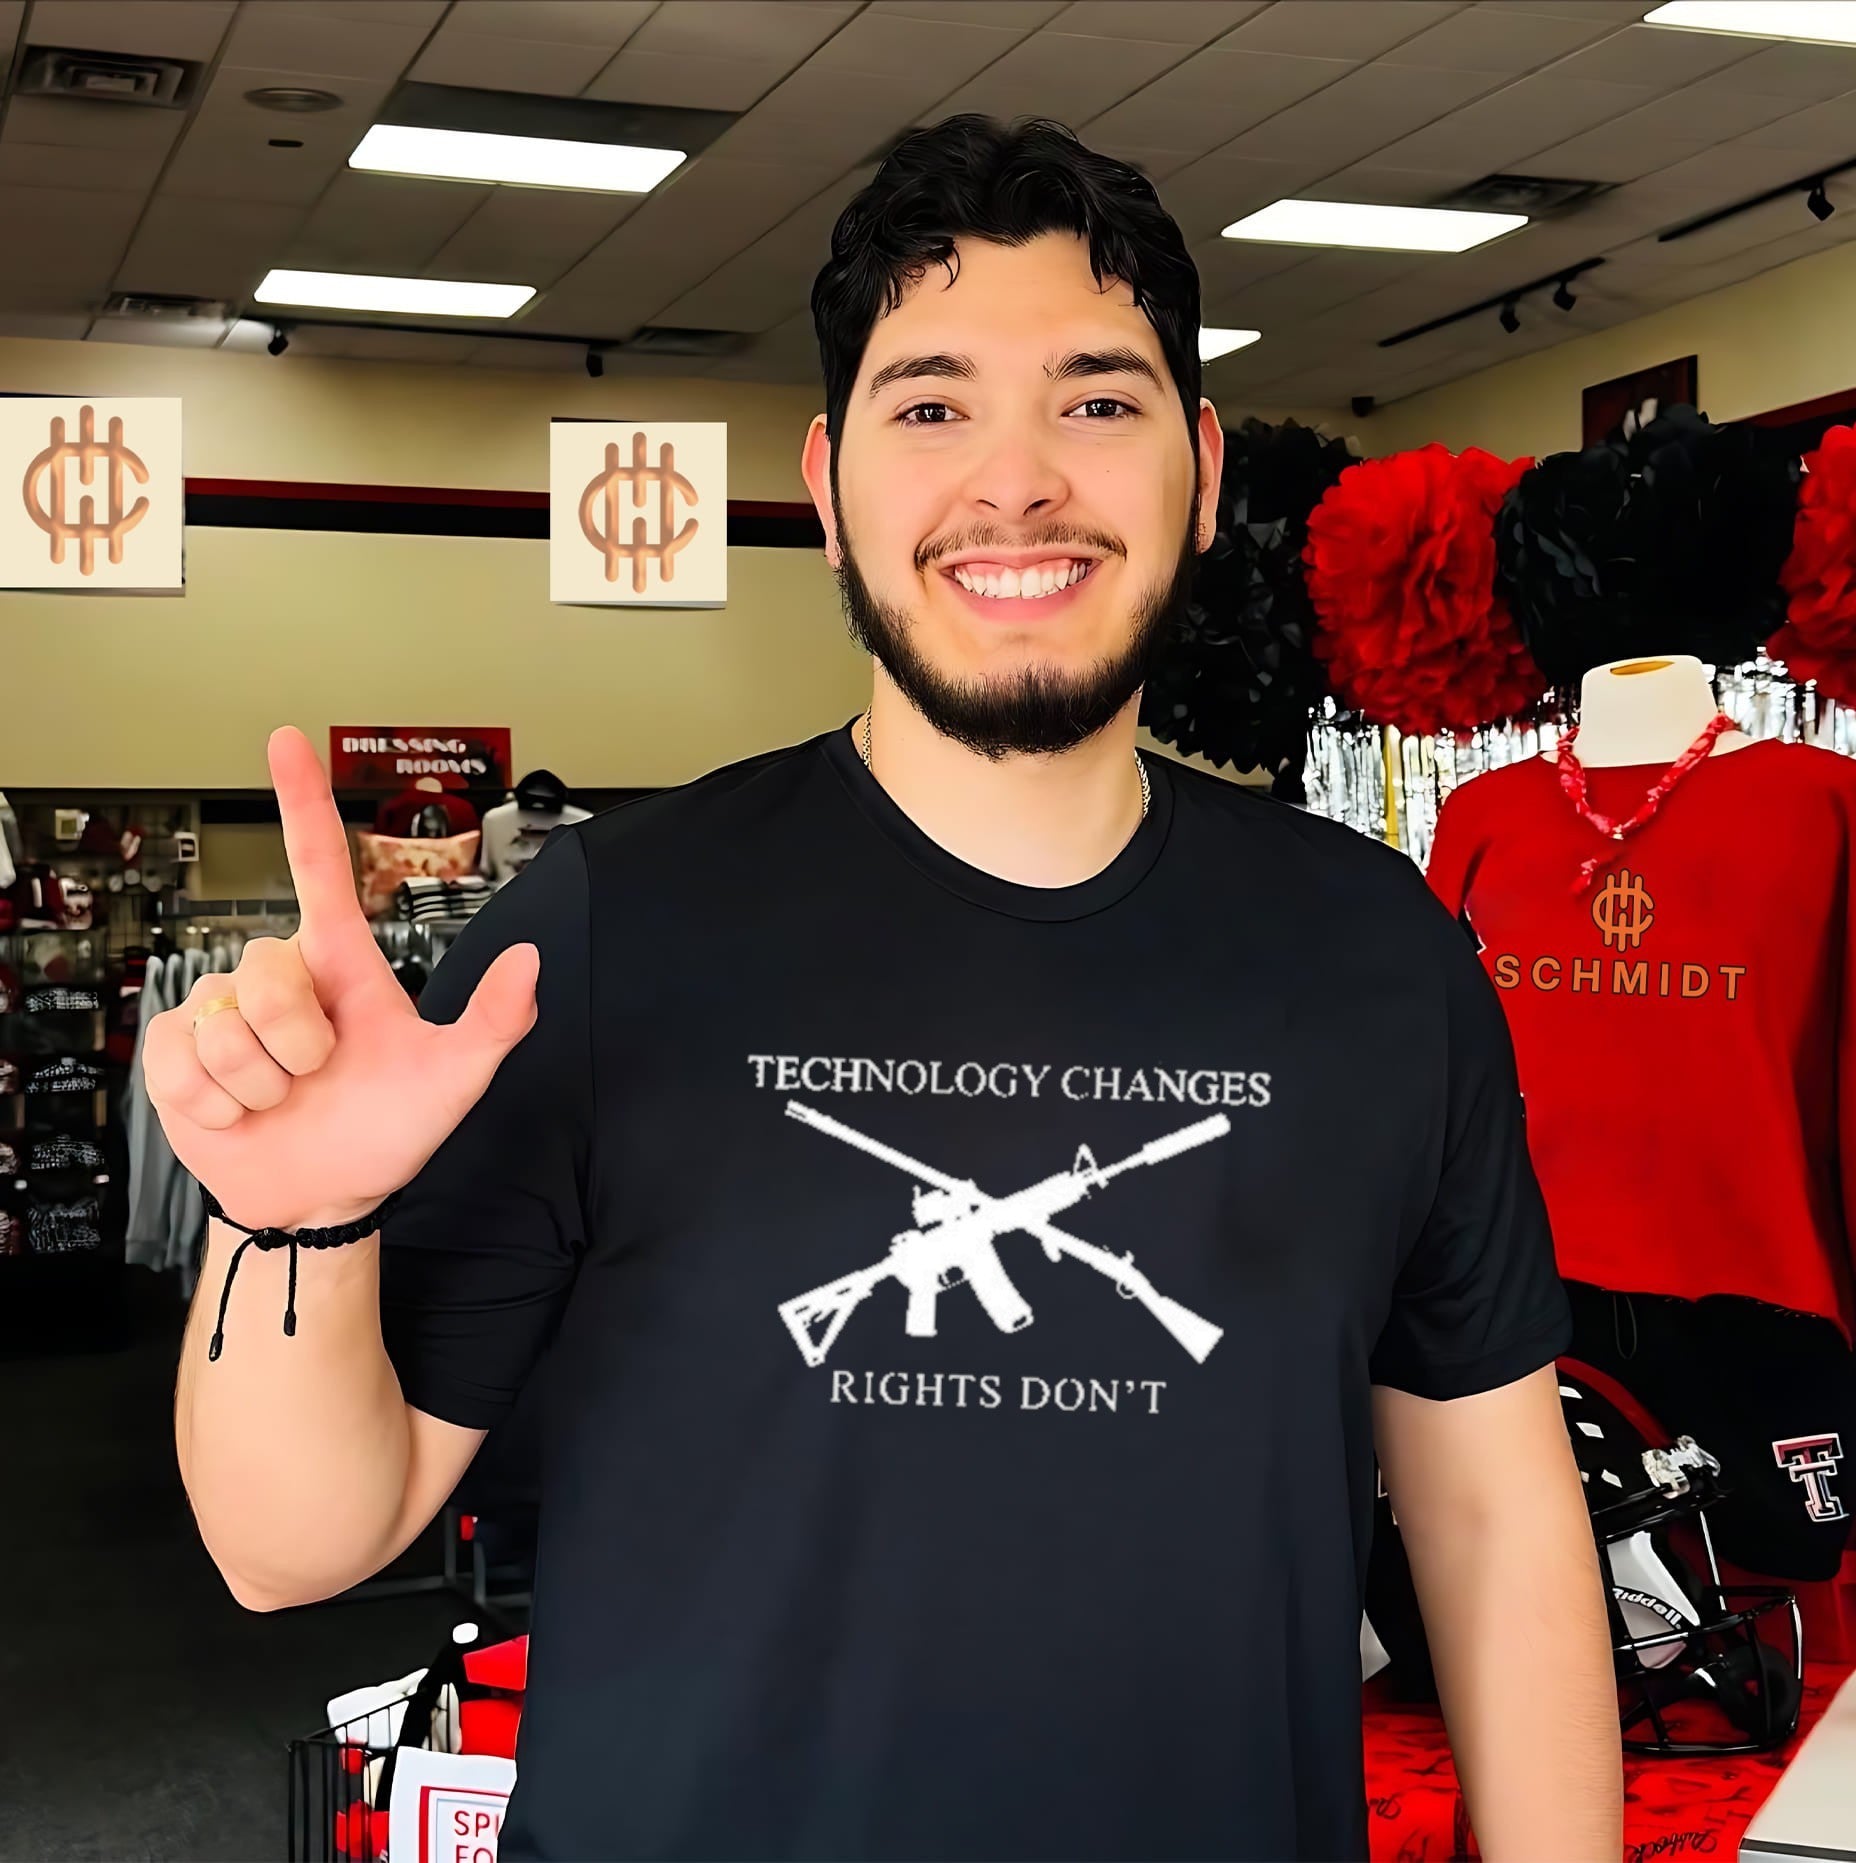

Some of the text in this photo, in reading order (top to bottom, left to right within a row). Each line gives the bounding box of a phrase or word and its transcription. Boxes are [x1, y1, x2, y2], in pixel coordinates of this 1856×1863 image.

[395, 757, 487, 775] ROOMS
[1493, 953, 1747, 1000] SCHMIDT
[747, 1054, 1272, 1107] TECHNOLOGY CHANGES
[830, 1370, 1167, 1414] RIGHTS DON'T
